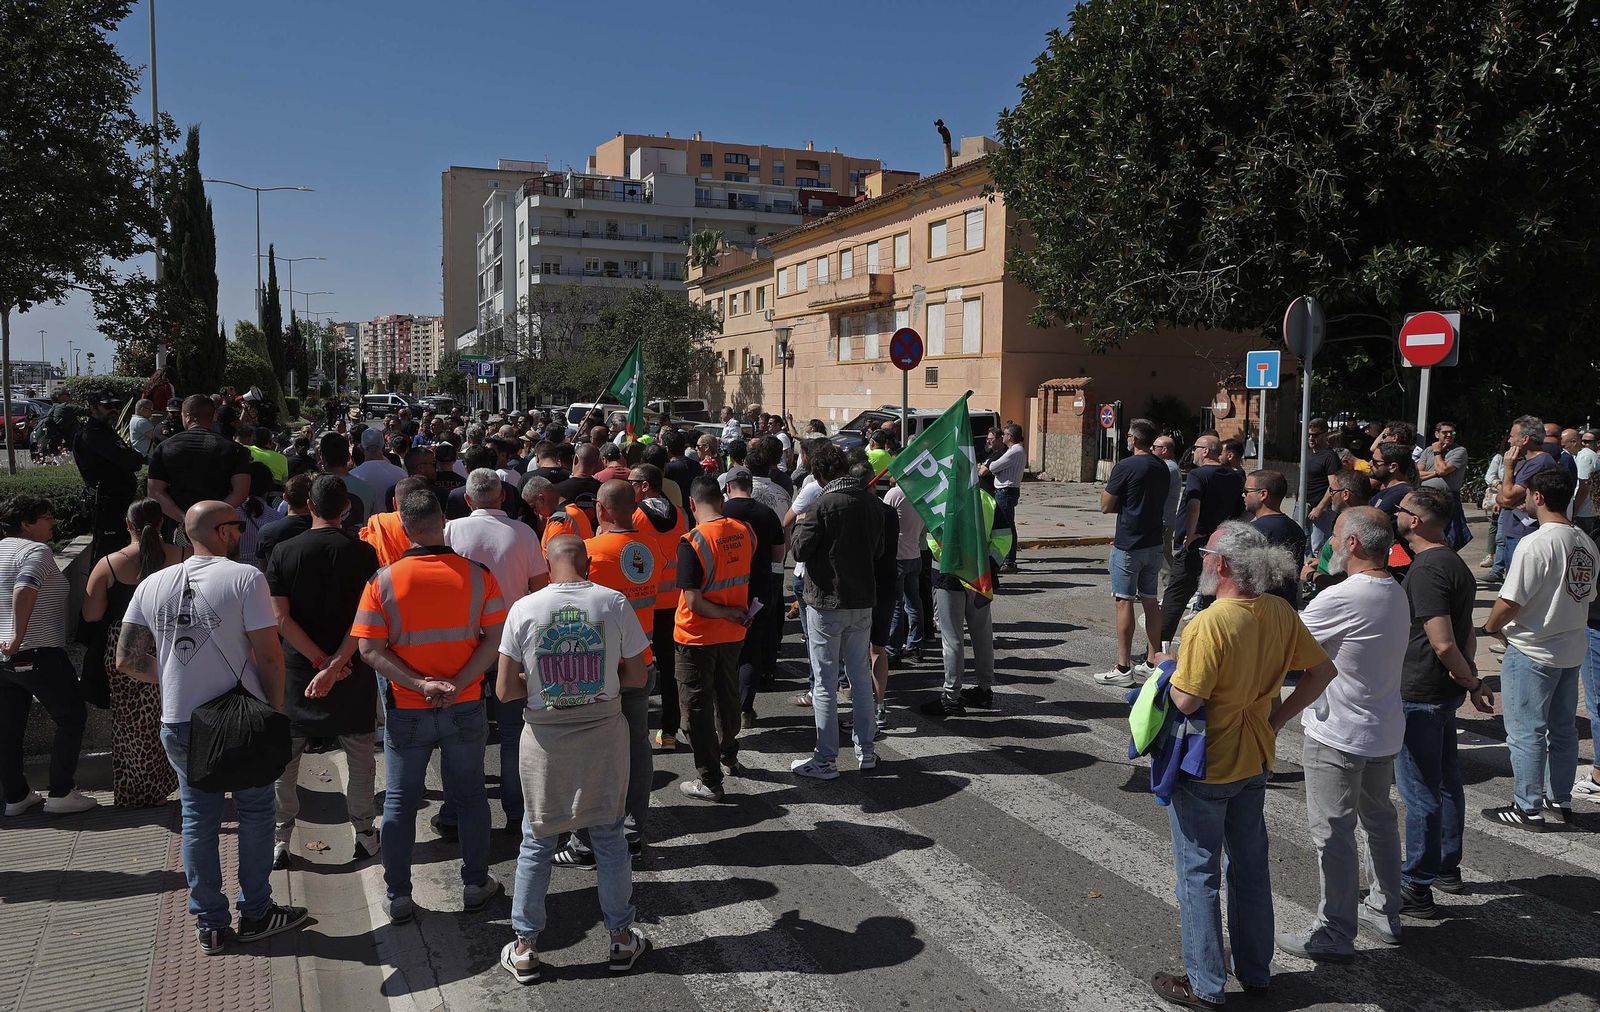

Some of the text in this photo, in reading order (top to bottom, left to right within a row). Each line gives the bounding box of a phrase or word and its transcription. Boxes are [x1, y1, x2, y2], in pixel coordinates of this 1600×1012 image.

[561, 611, 579, 621] THE
[539, 621, 604, 651] MOMENT
[540, 653, 601, 684] TRUTH
